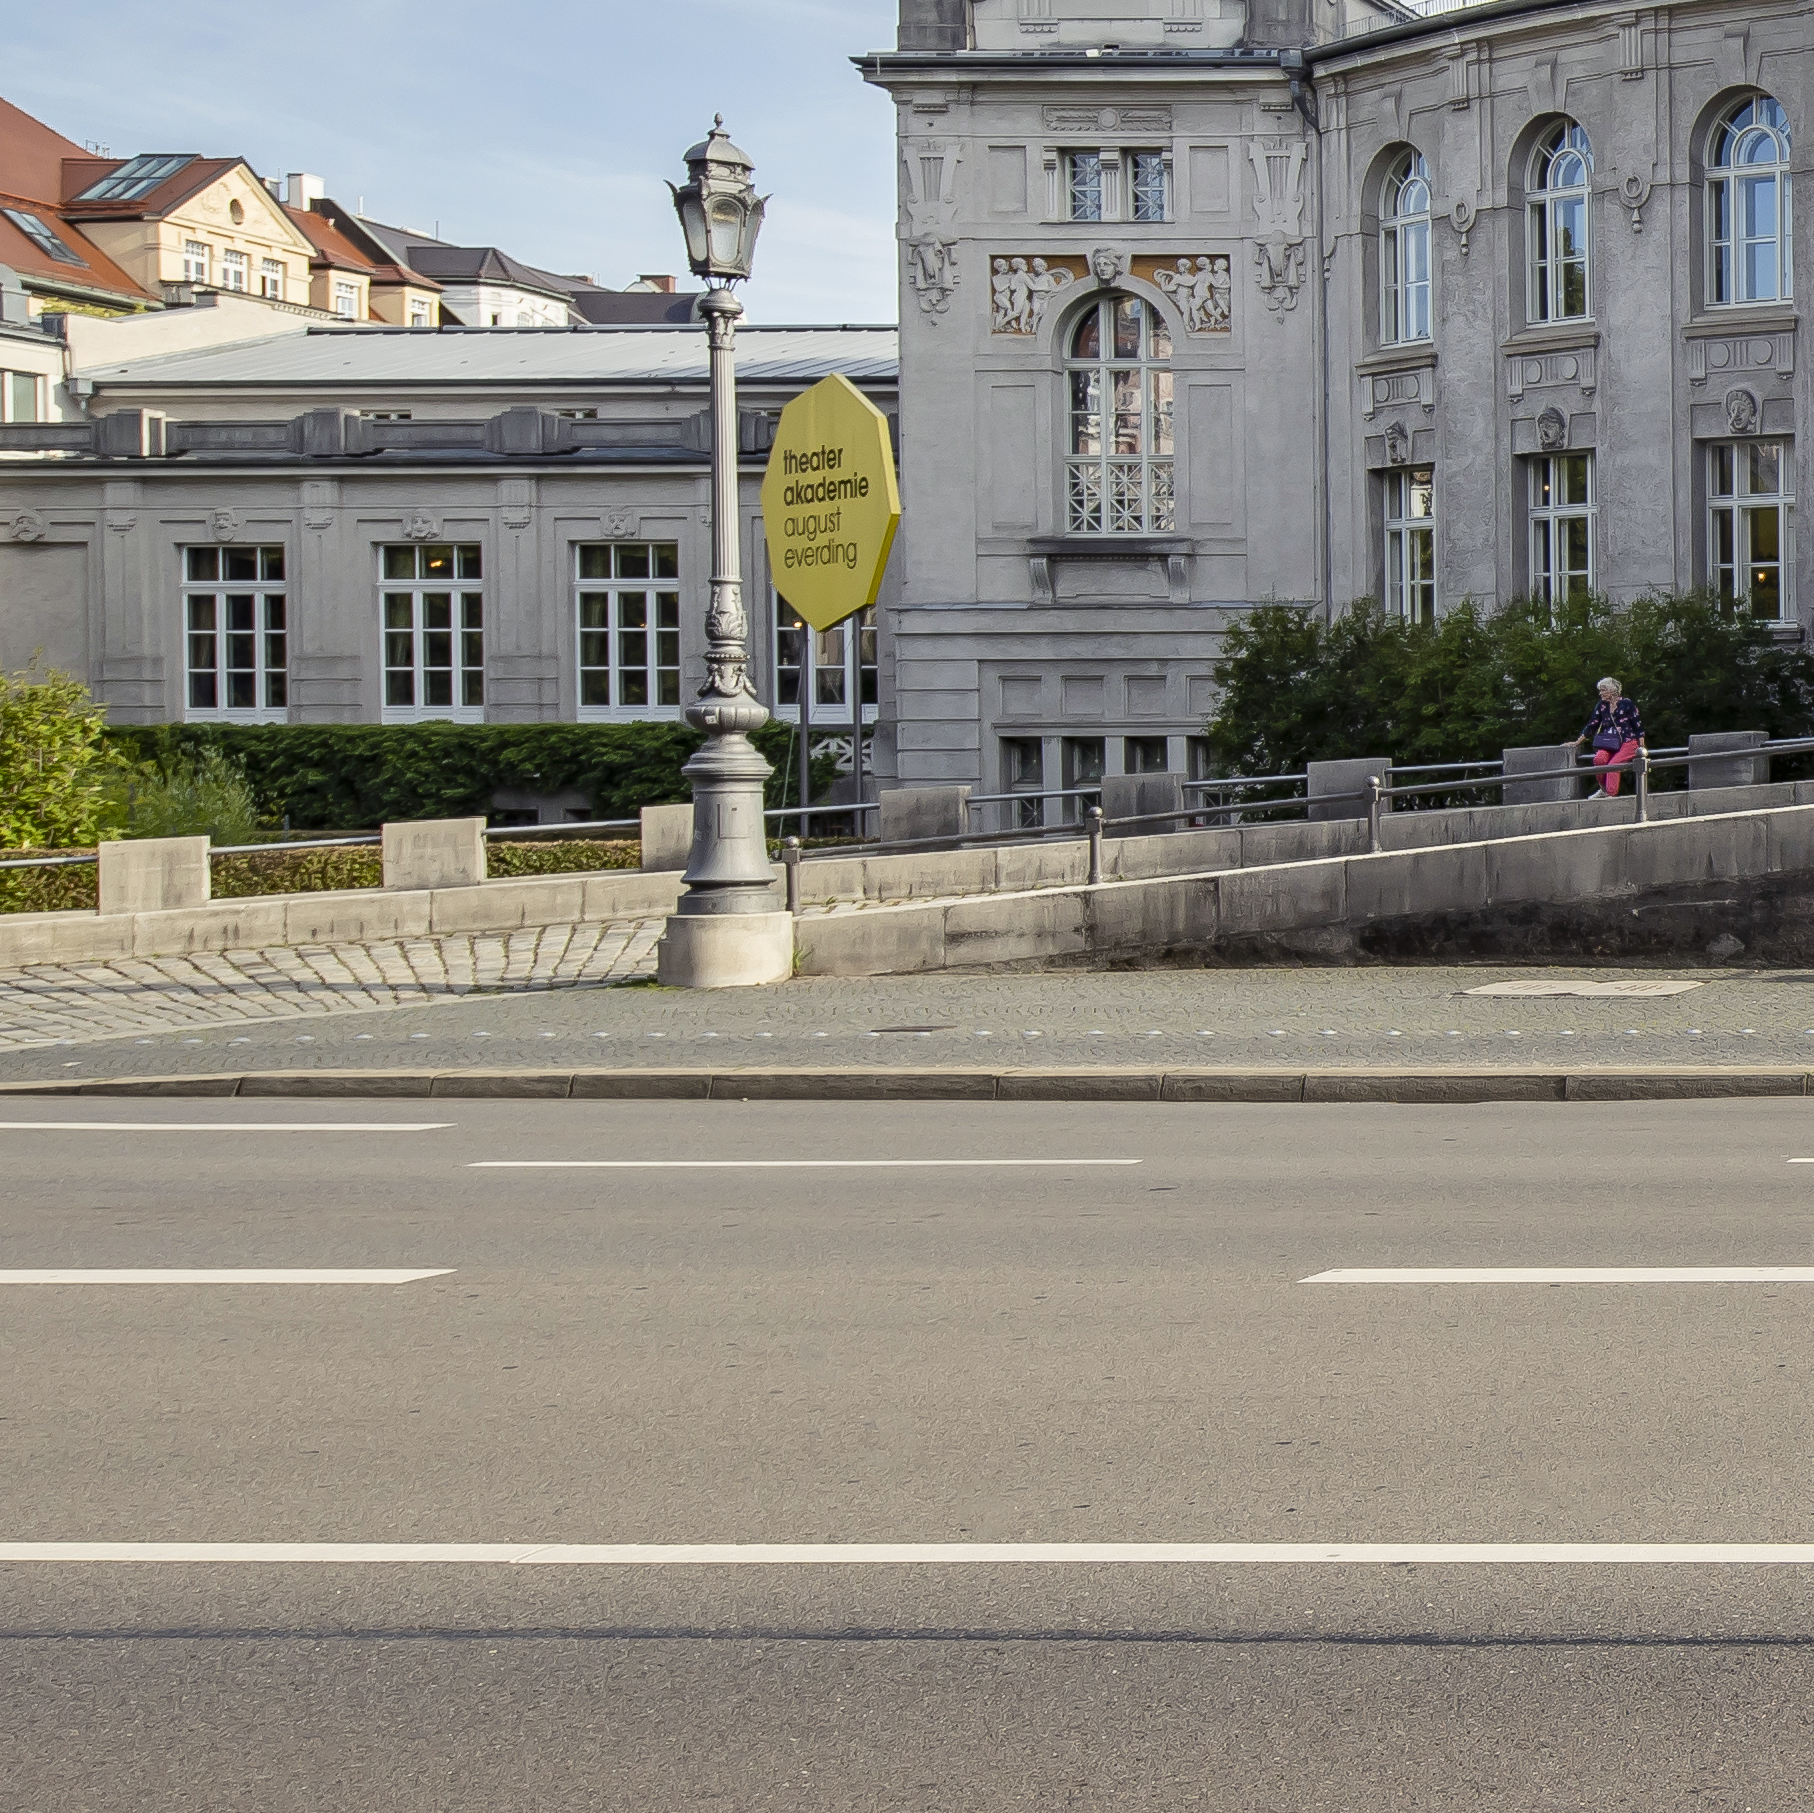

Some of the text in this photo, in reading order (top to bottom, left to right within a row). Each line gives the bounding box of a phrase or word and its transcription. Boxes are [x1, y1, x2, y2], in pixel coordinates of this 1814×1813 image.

[783, 444, 844, 476] theater
[783, 471, 869, 507] akademie
[783, 506, 844, 542] august
[783, 538, 859, 570] everding
